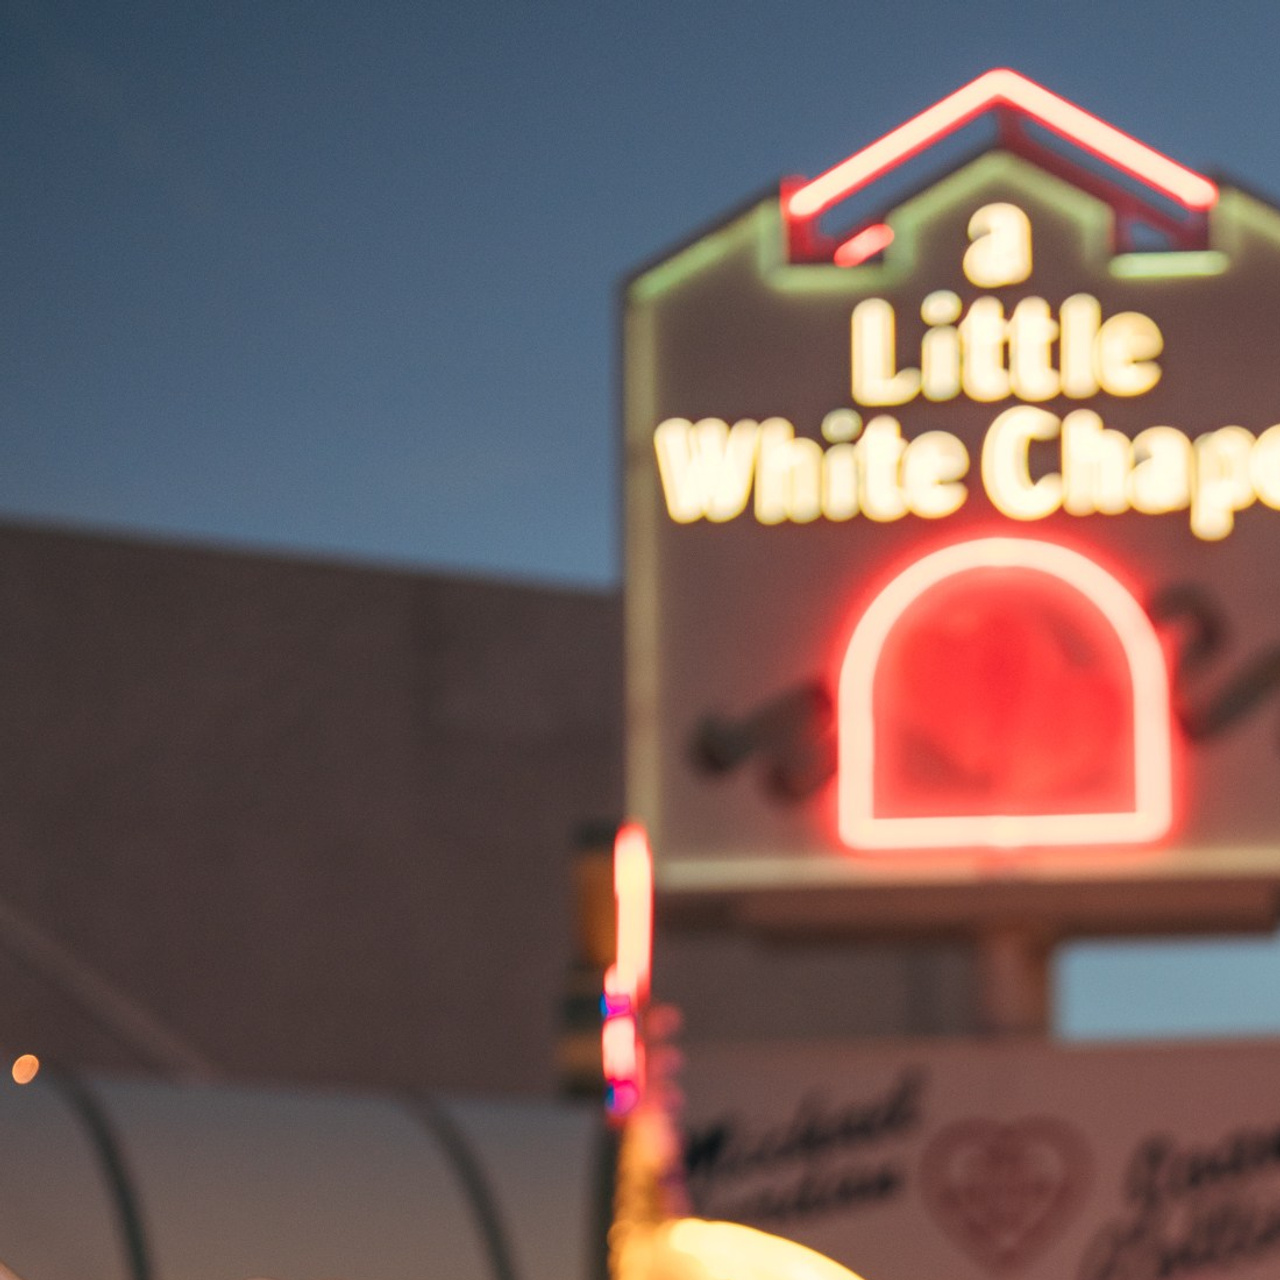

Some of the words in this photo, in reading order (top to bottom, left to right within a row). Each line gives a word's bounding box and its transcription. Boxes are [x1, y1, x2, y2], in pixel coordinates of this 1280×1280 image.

[963, 202, 1033, 288] a
[851, 290, 1163, 406] Little
[654, 407, 970, 525] White
